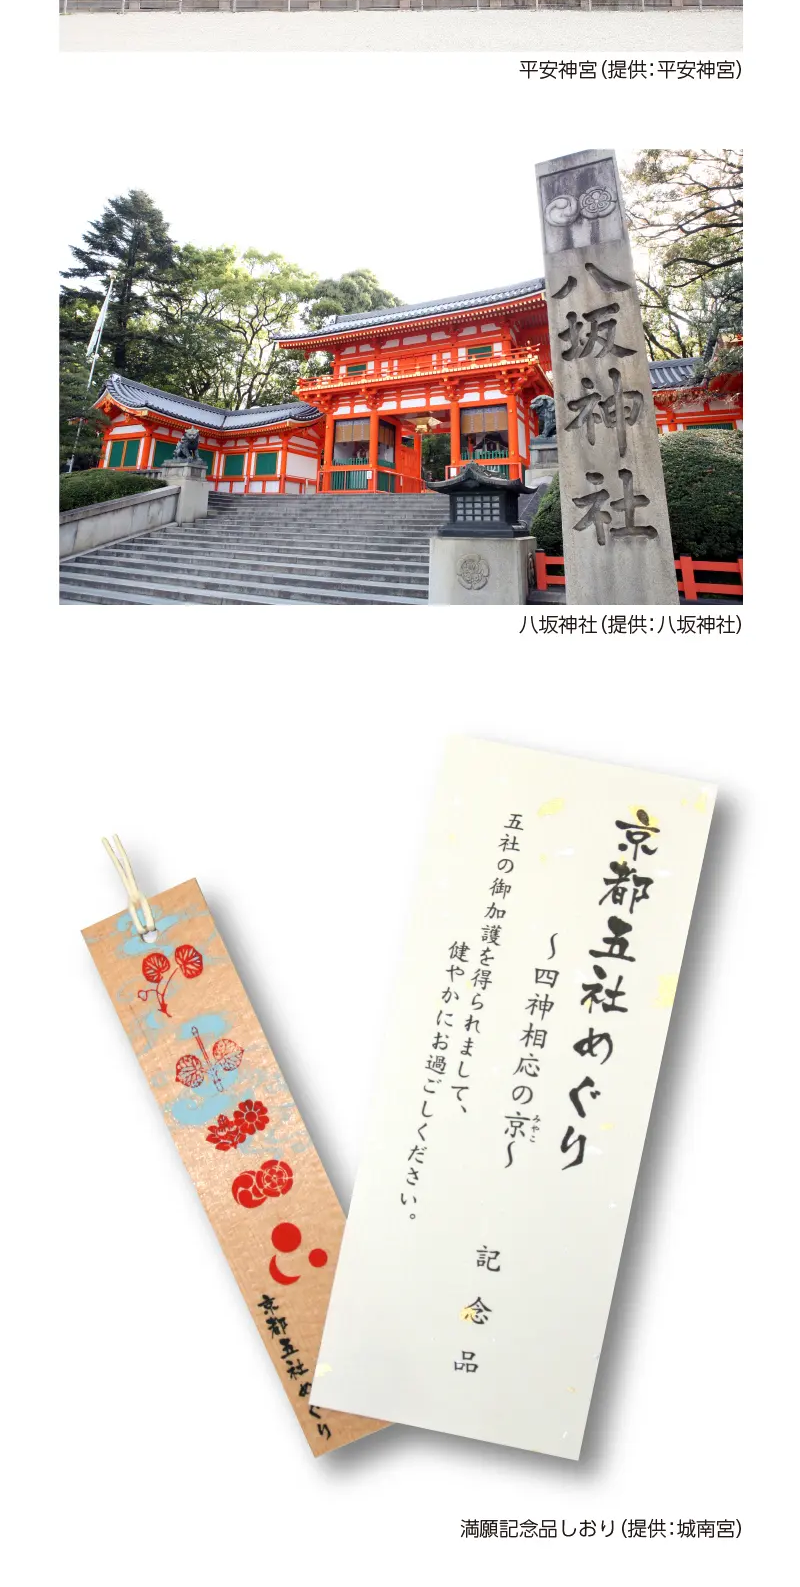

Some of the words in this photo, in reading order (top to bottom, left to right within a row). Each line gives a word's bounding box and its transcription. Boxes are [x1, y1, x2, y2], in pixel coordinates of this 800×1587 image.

[551, 262, 659, 547] 八坂神社
[399, 940, 471, 1221] 健やかにお過ごしください。
[450, 813, 525, 1114] 五社の御加護を得られまして、
[560, 809, 661, 1171] 京都五社めぐり
